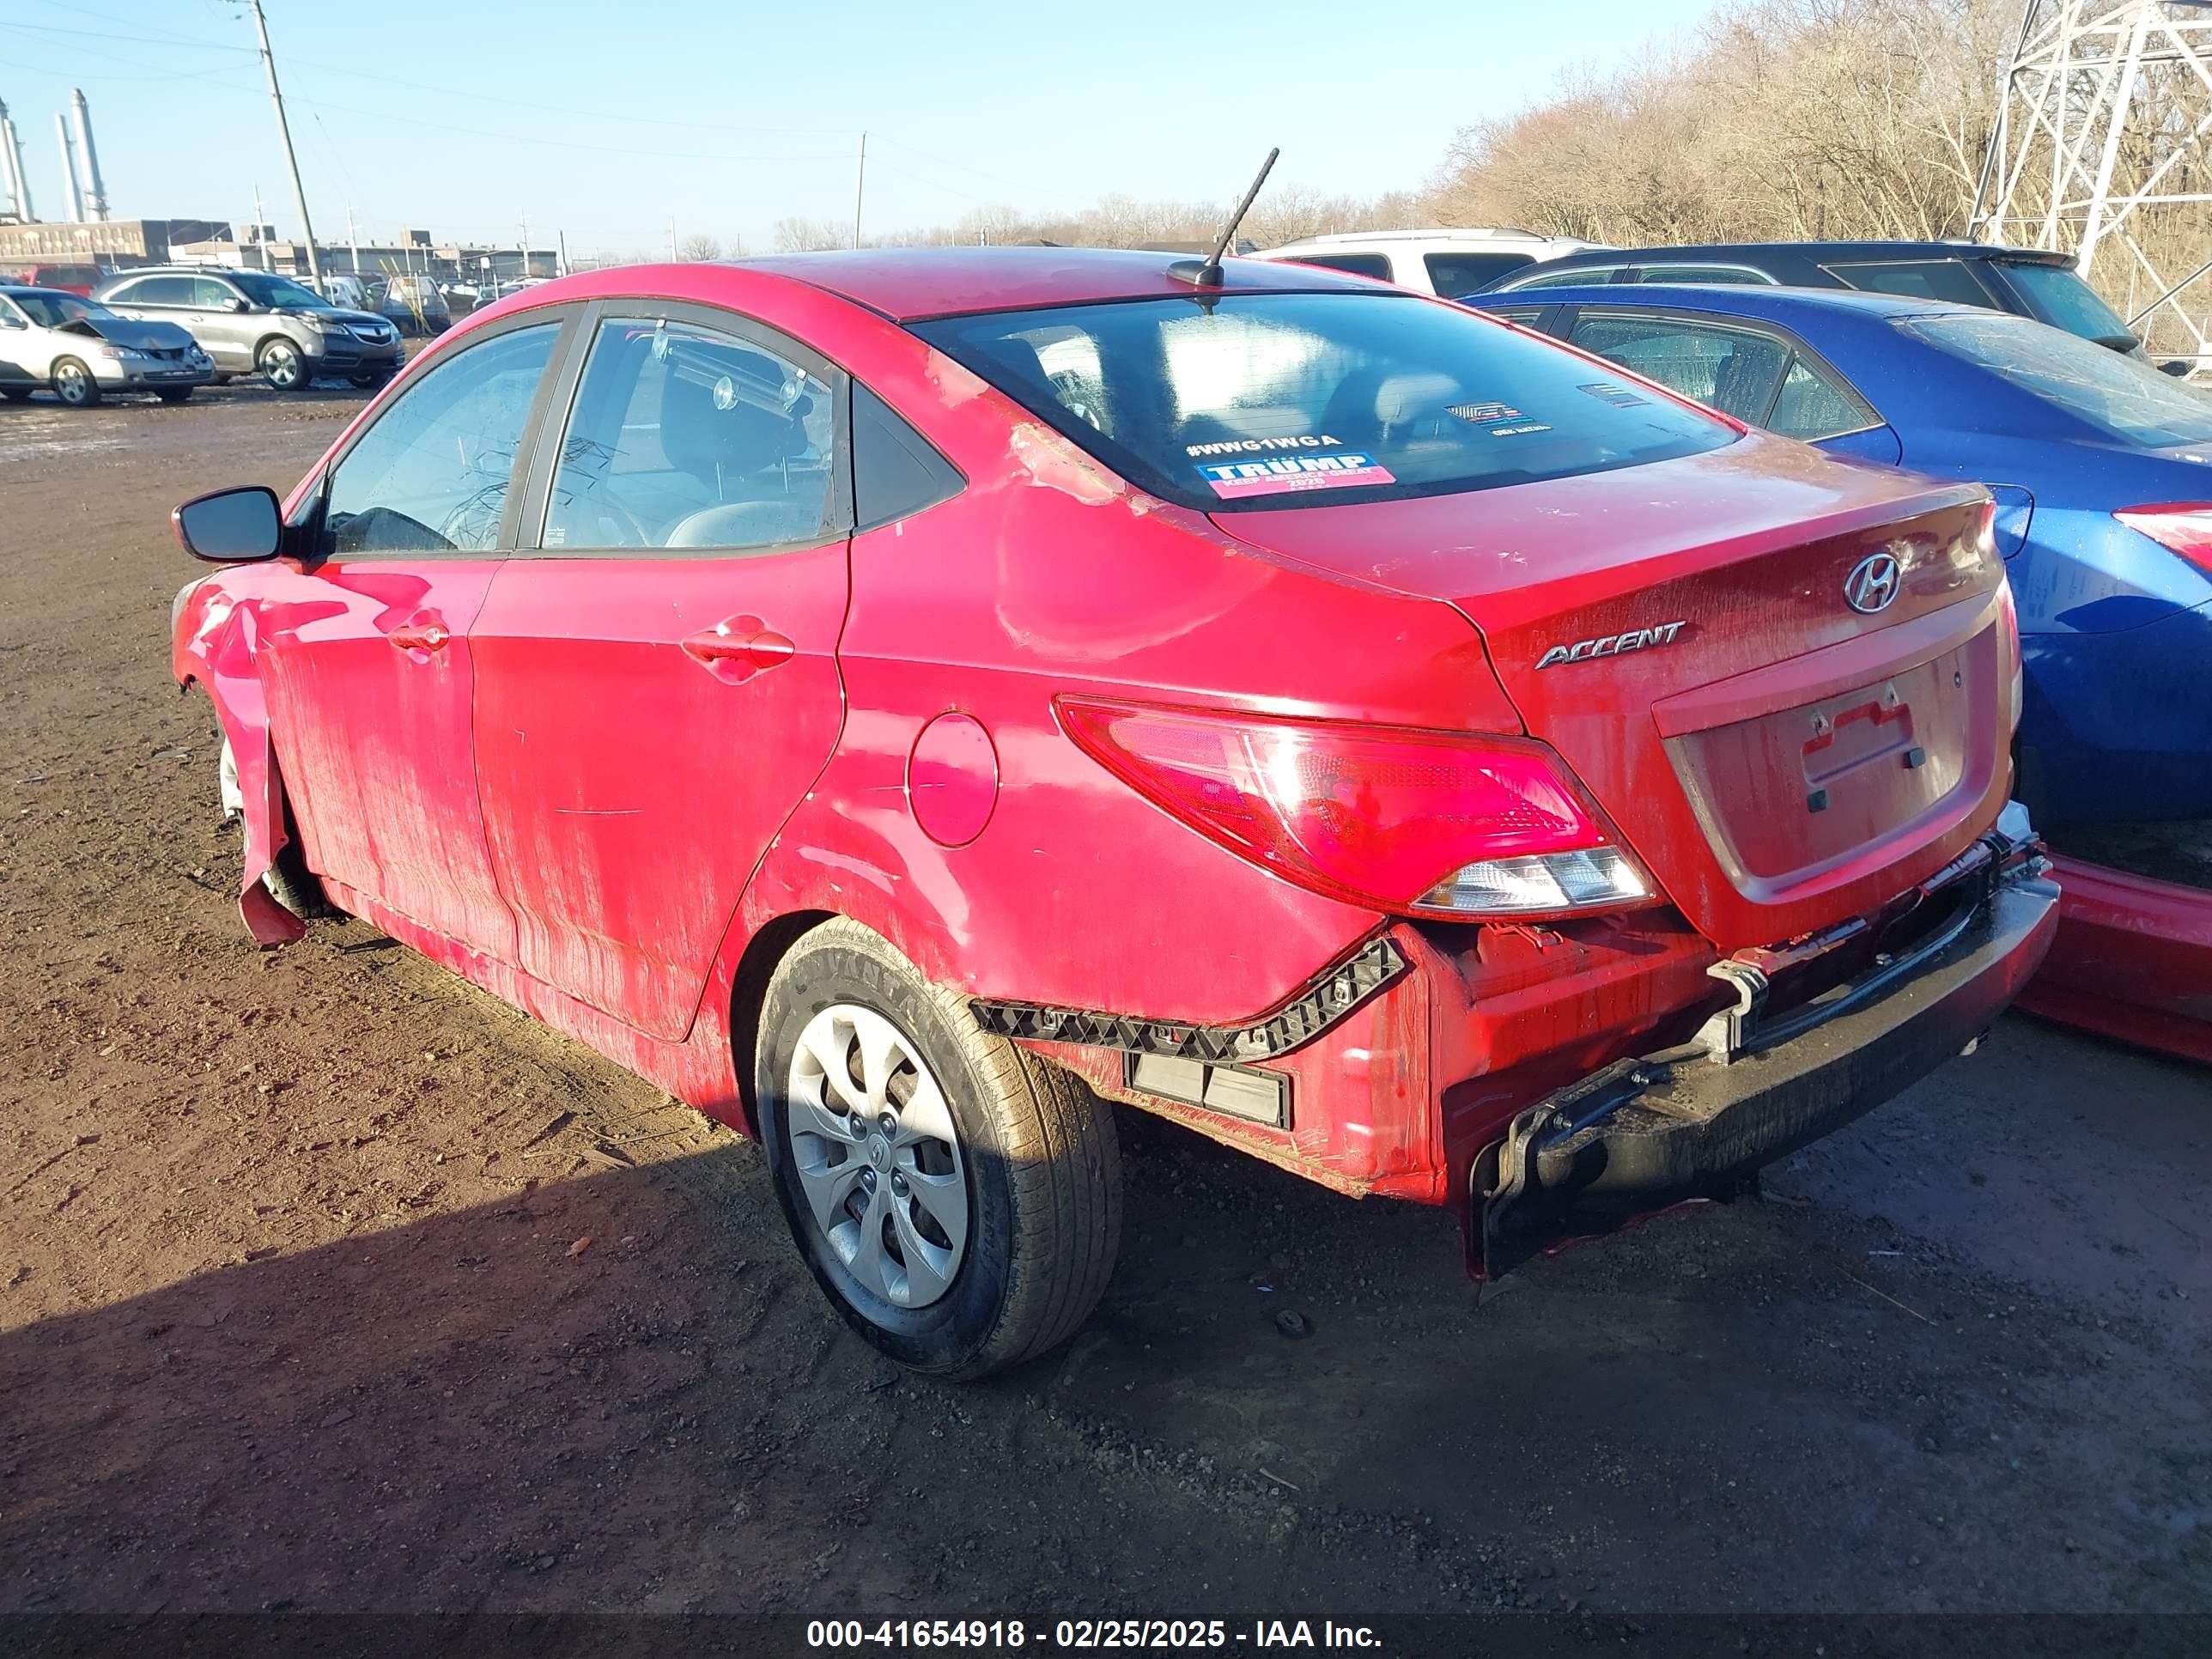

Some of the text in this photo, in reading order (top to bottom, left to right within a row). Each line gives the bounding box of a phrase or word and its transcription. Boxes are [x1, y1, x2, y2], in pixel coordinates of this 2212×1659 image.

[1186, 434, 1343, 456] #WWG1WGA
[1207, 455, 1367, 479] TRUMP
[1224, 466, 1374, 487] KEEP AMERICA GREAT
[1287, 477, 1325, 487] 2020
[1534, 620, 1687, 670] ACCENT
